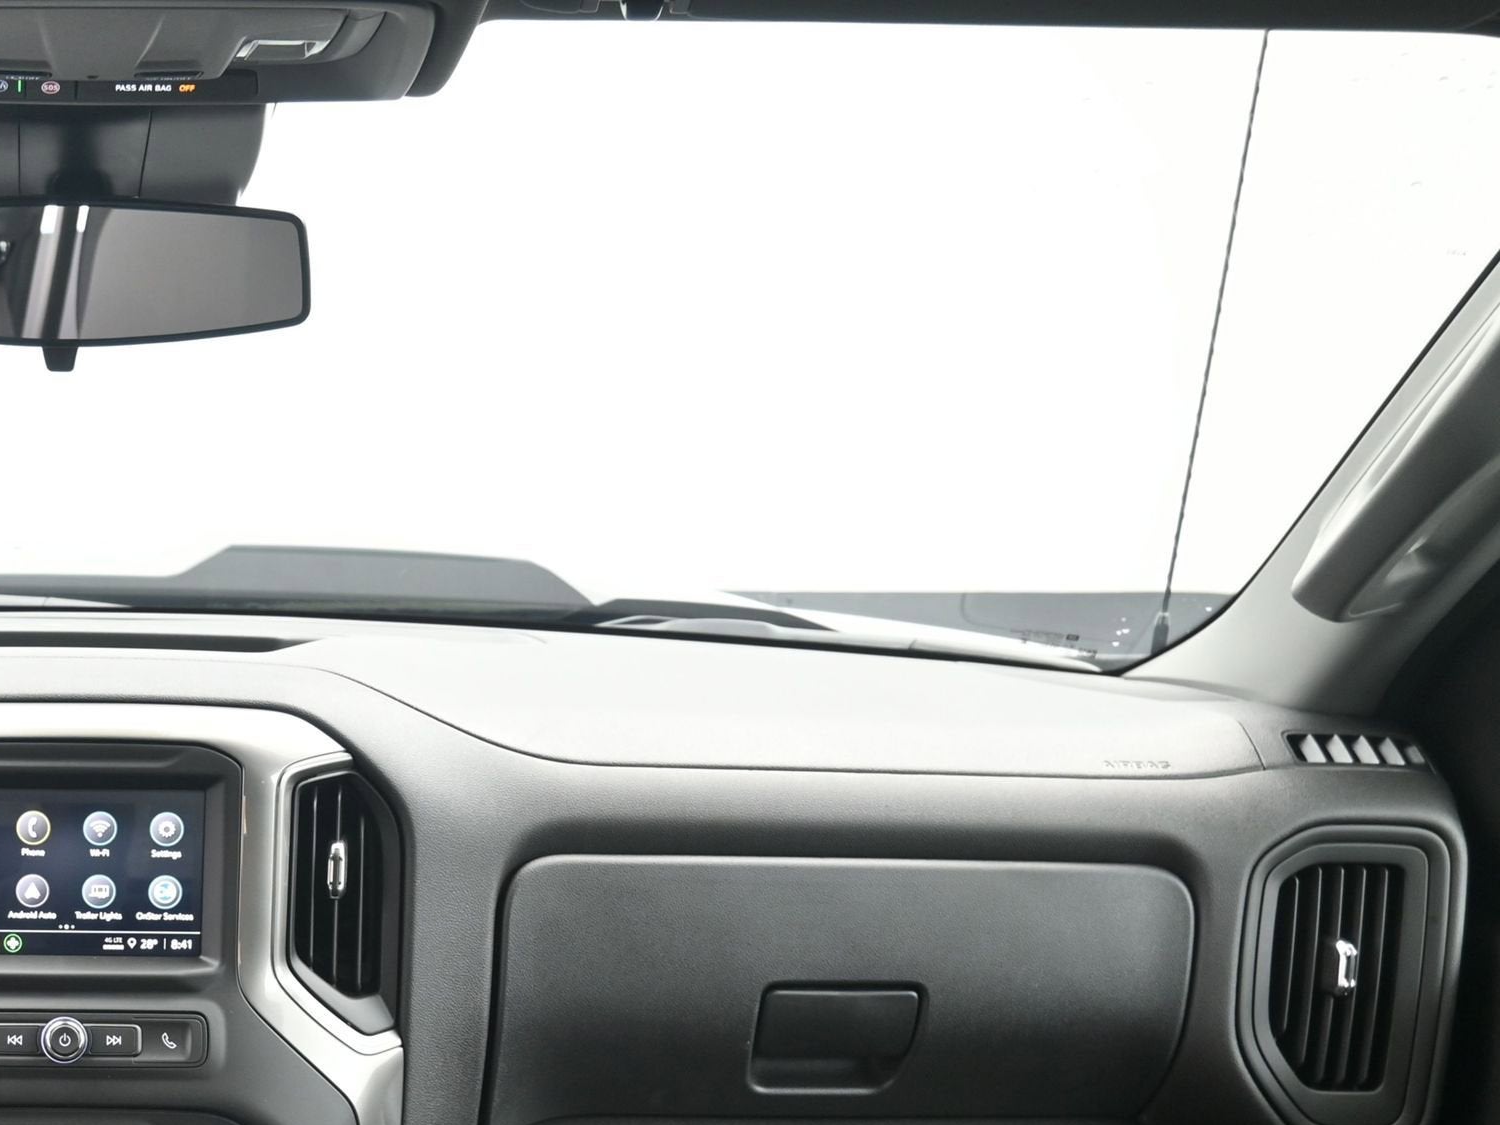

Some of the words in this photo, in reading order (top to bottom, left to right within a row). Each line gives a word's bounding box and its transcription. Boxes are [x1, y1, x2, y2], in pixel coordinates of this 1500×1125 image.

[42, 83, 59, 91] SOS
[115, 83, 137, 92] PASS
[138, 83, 153, 92] AIR
[154, 83, 172, 92] BAG
[178, 83, 196, 92] OFF
[21, 847, 46, 857] Phone
[151, 849, 182, 860] Settings
[7, 910, 37, 920] Android
[38, 910, 57, 920] Auto
[74, 910, 99, 921] Trailer
[100, 911, 123, 922] Lights
[136, 911, 162, 921] OnStar
[163, 911, 194, 922] Services
[170, 938, 192, 950] 8:41
